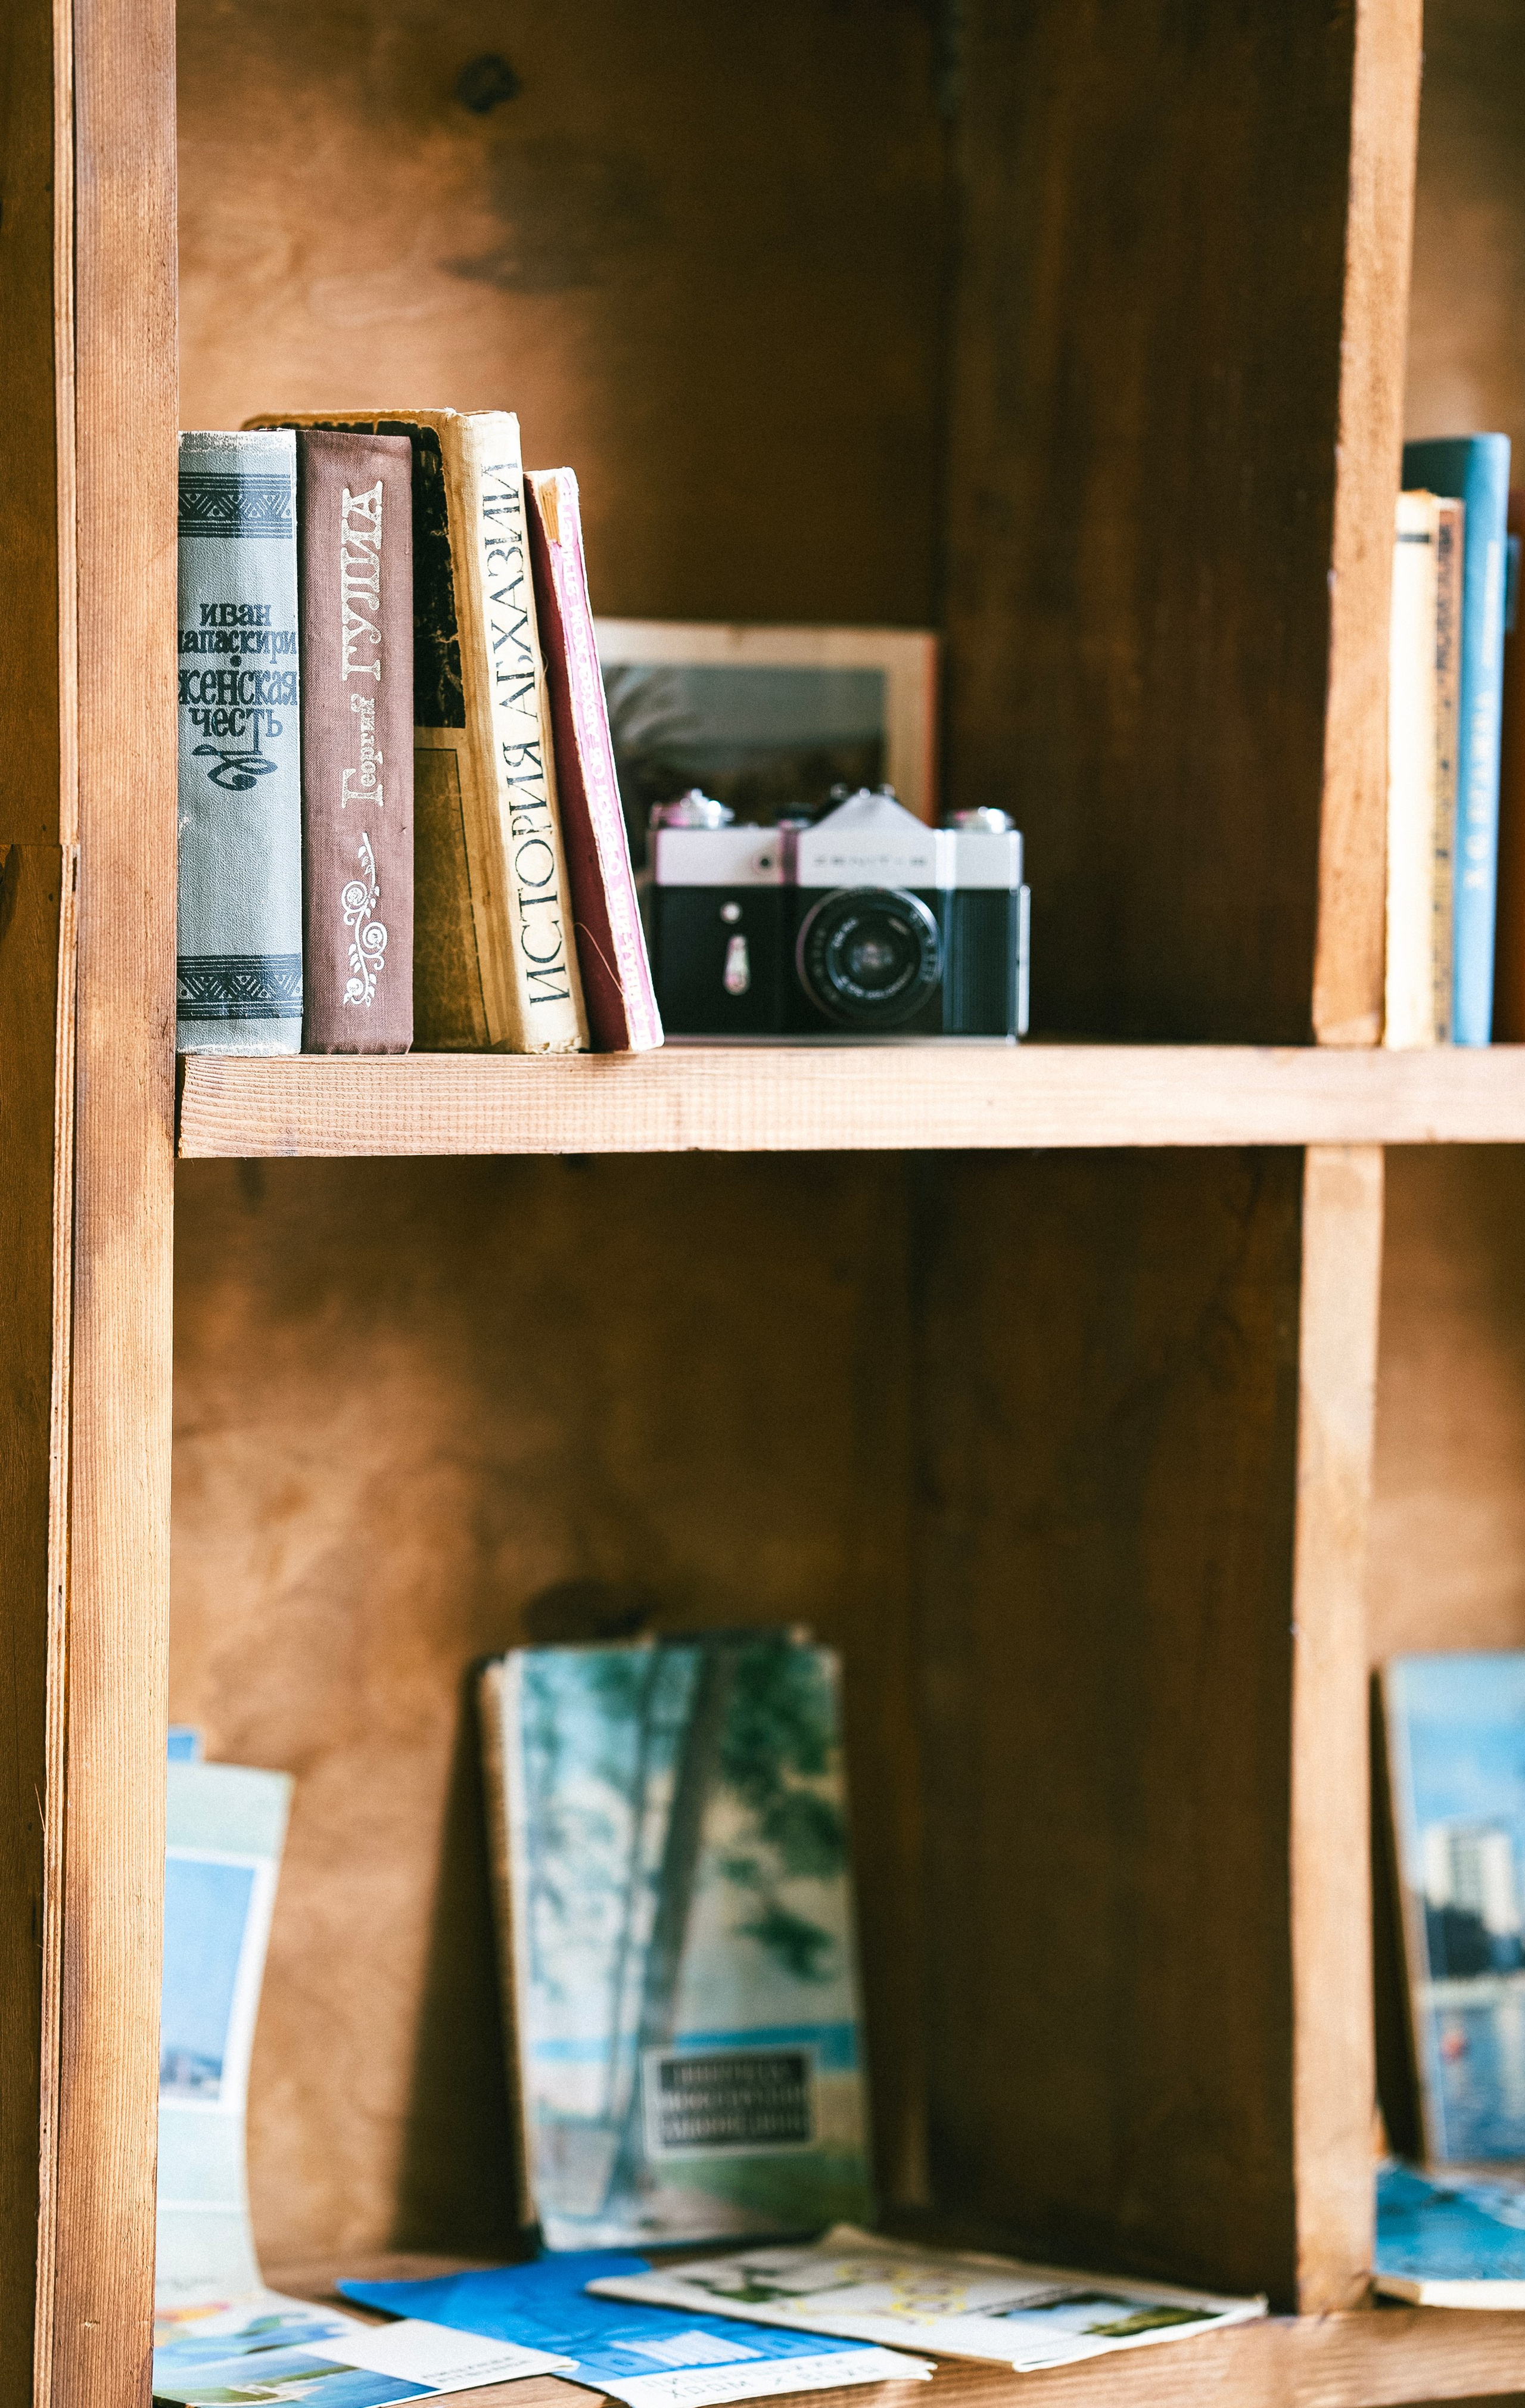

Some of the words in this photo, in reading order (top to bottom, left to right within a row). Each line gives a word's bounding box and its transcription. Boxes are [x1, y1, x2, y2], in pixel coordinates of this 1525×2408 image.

[200, 603, 272, 626] иван
[340, 480, 383, 681] ГУЛИА
[341, 692, 384, 809] Георгий
[502, 740, 570, 1005] ИСТОРИЯ
